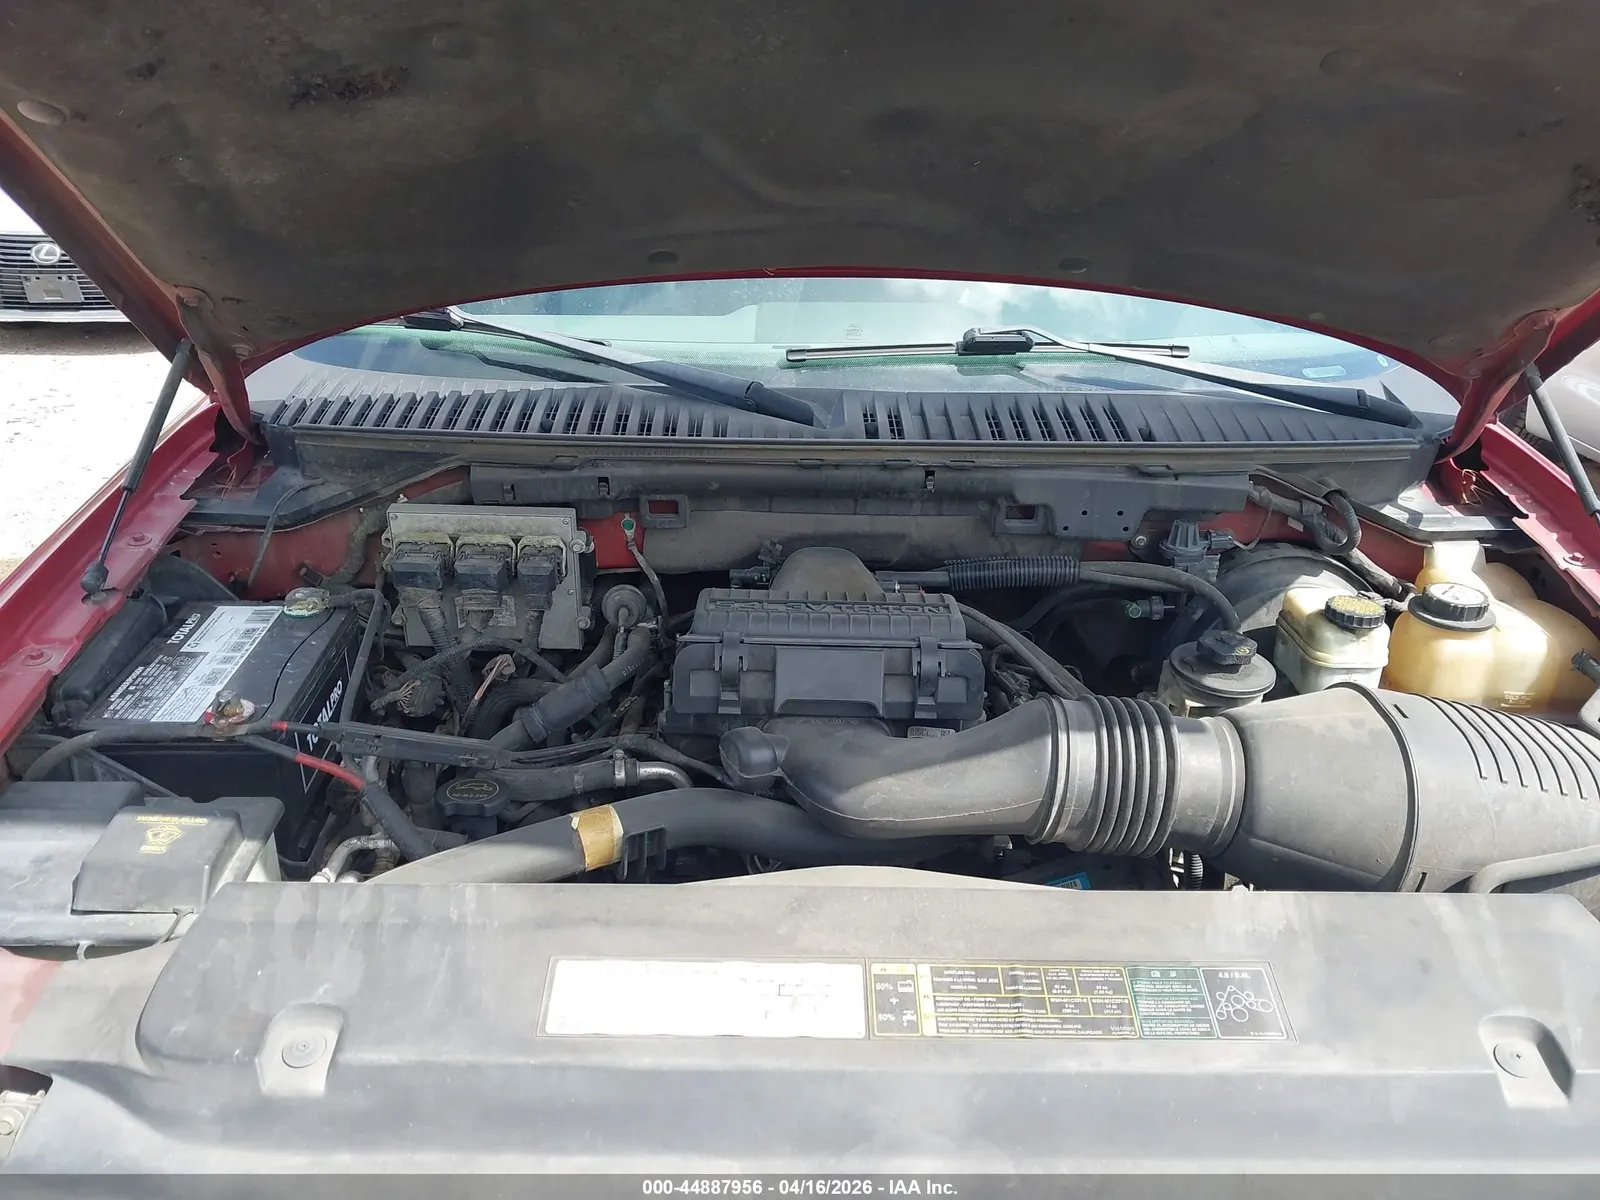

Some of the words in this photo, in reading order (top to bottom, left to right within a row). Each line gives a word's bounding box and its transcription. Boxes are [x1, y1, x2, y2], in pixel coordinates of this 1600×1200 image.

[834, 603, 945, 614] TRITON
[167, 613, 200, 644] TOTALPRO
[179, 816, 208, 825] FLUID
